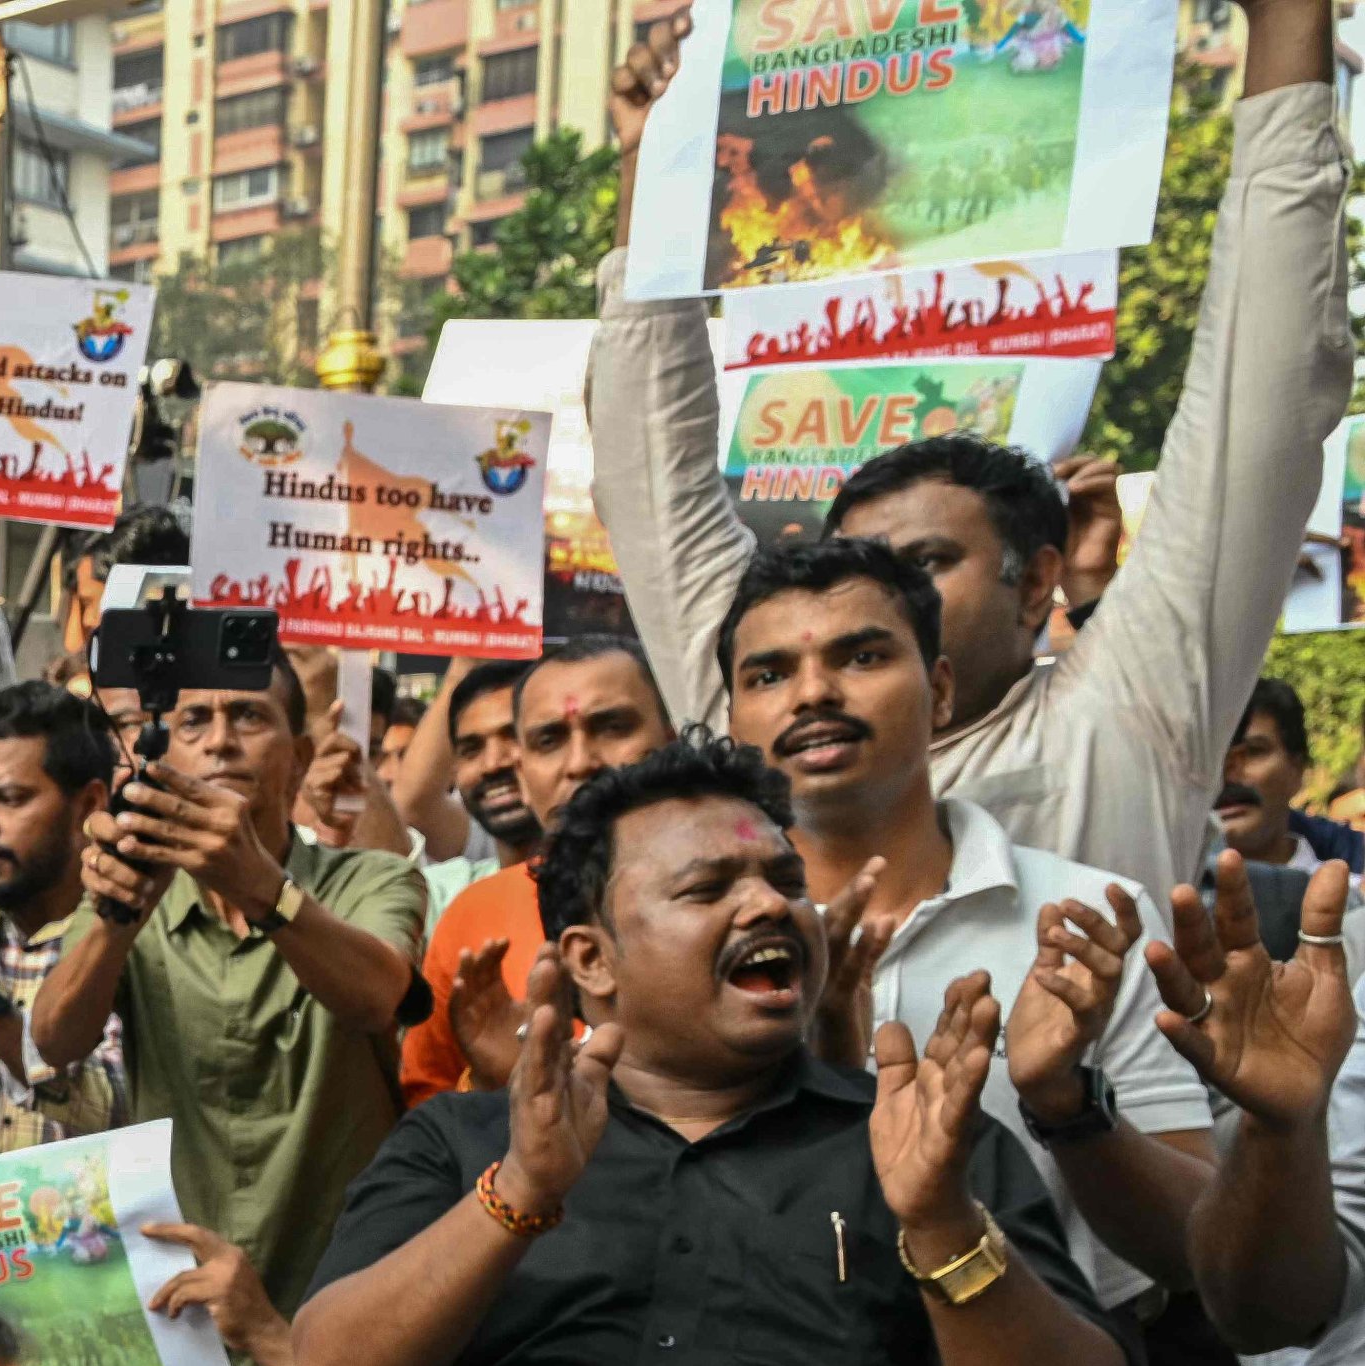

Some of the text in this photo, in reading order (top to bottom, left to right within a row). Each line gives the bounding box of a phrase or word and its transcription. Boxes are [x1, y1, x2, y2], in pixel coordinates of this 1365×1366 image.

[753, 25, 958, 73] BANGLADESHI
[746, 47, 955, 118] HINDUS
[13, 360, 93, 384] attacks
[99, 367, 127, 387] on
[754, 394, 917, 447] SAVE
[263, 470, 492, 515] Hindus too have
[740, 466, 857, 503] HIND
[267, 522, 481, 565] Human rights..
